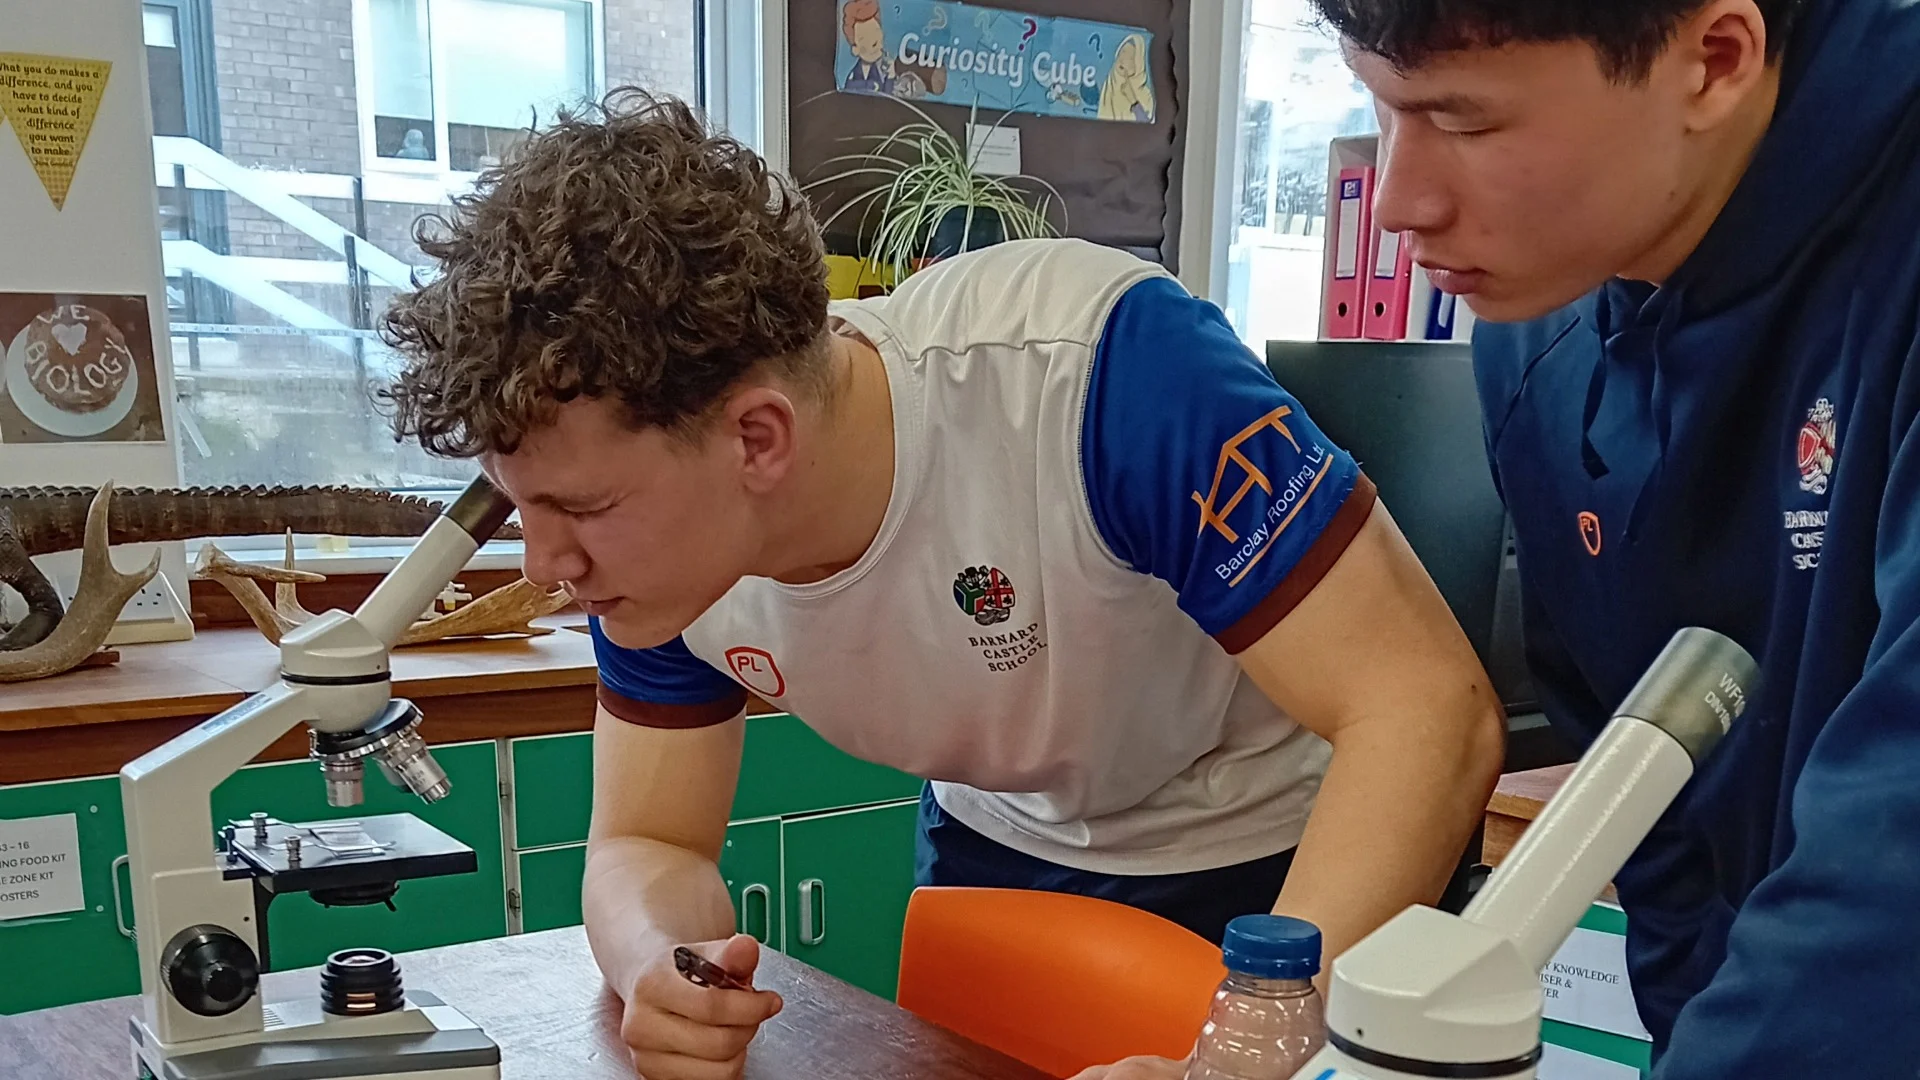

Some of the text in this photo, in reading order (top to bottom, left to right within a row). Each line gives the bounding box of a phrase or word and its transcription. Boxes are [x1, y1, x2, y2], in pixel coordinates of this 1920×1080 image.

[899, 32, 1097, 88] Curiosity Cube
[0, 62, 99, 79] hat you do makes a
[54, 80, 72, 90] and
[75, 84, 93, 93] you
[12, 90, 83, 104] have to decide
[17, 104, 80, 119] what kind of
[26, 117, 75, 130] difference
[29, 134, 74, 145] you want
[31, 146, 42, 154] to
[36, 304, 91, 324] WE
[26, 337, 128, 395] BIOLOGY
[1214, 522, 1270, 580] Barclay
[1267, 464, 1316, 524] Roofing
[1792, 553, 1821, 571] SC
[968, 622, 1039, 648] BARNARD
[982, 635, 1038, 660] CASTLE
[737, 656, 763, 672] PL
[987, 642, 1048, 672] SCHOOL
[18, 841, 30, 850] 16
[20, 855, 50, 866] FOOD
[51, 853, 67, 863] KIT
[9, 872, 37, 885] ZONE
[39, 870, 54, 881] KIT
[0, 889, 40, 902] OSTERS
[1553, 961, 1620, 984] KNOWLEDGE
[1564, 978, 1573, 989] &
[1544, 987, 1560, 999] ER
